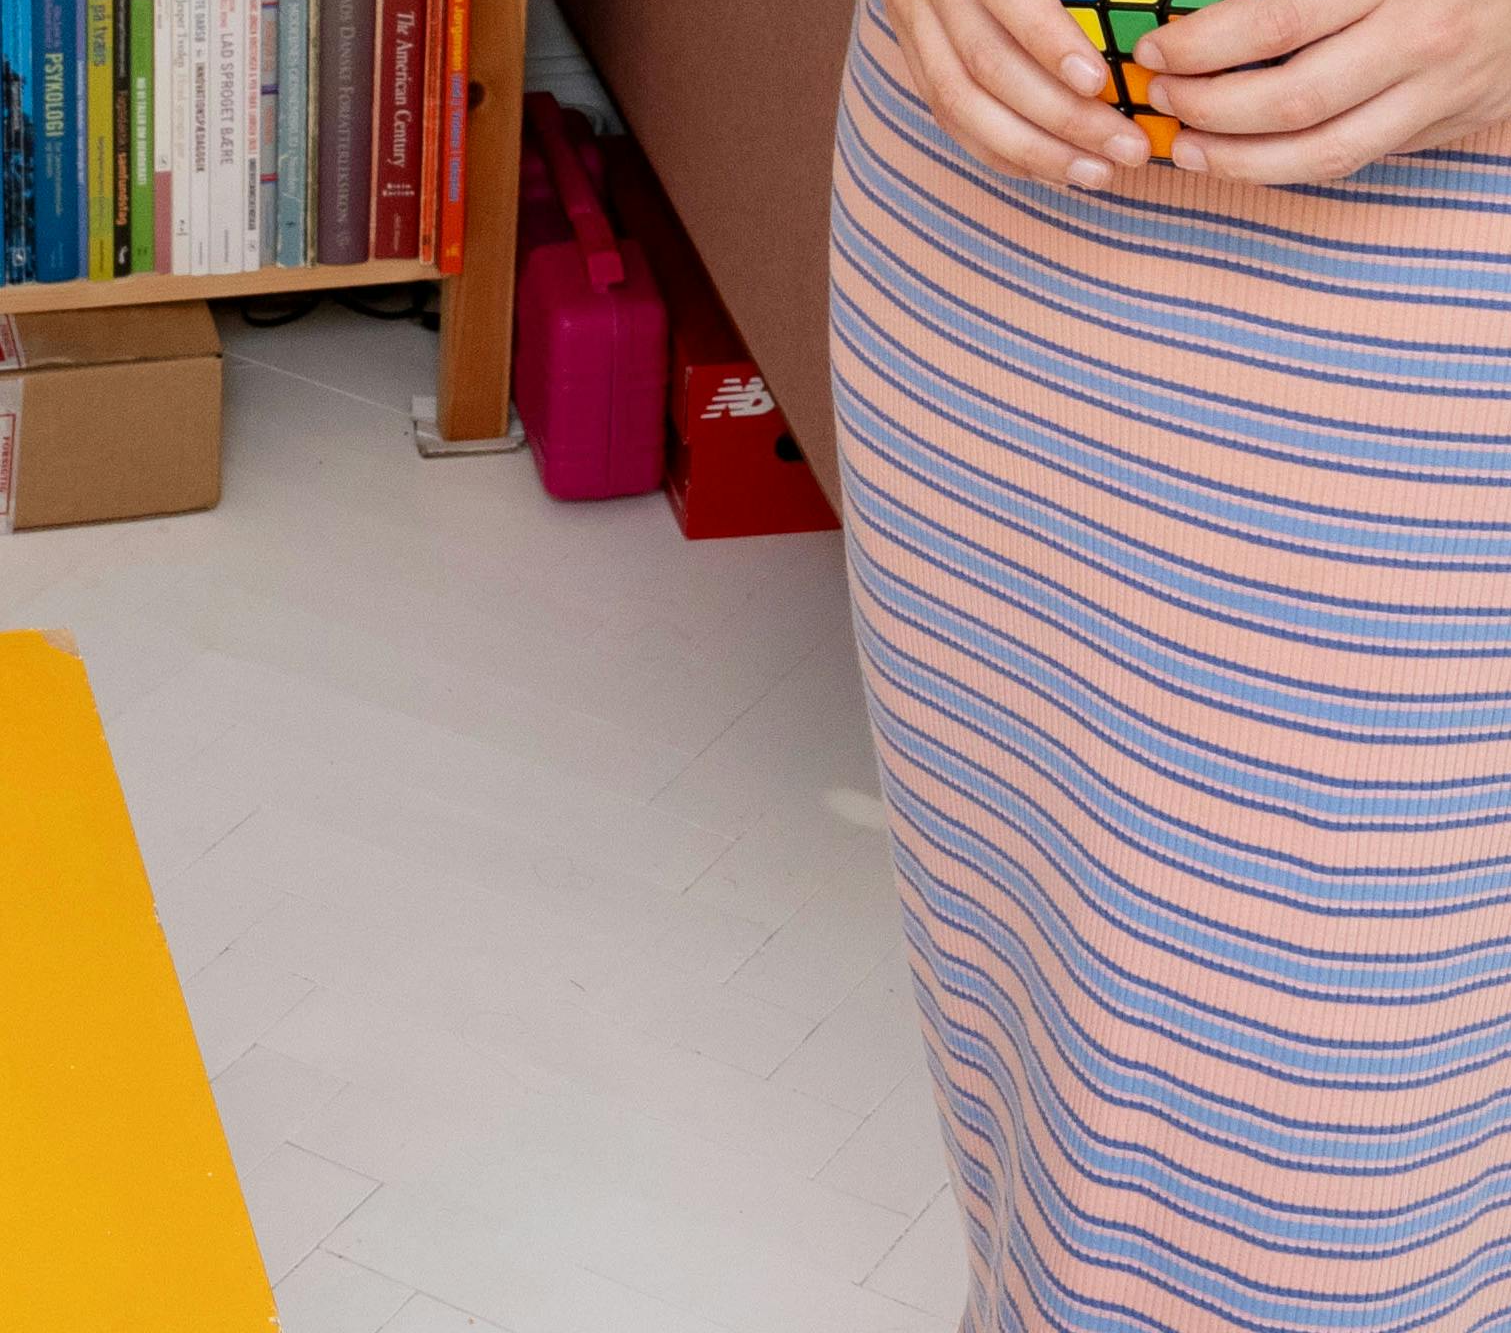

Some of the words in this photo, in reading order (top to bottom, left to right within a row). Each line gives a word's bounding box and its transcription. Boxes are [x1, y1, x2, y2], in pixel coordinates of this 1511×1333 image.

[93, 4, 108, 21] på
[175, 0, 188, 28] Jesper
[396, 10, 414, 35] The
[93, 27, 110, 66] tværs
[220, 33, 234, 58] LAD
[338, 26, 354, 81] DANSKE
[394, 38, 414, 105] American
[45, 52, 65, 137] PSYKOLOGI
[220, 63, 235, 122] SPROGET
[220, 128, 234, 165] BÆRE
[388, 109, 414, 167] Century
